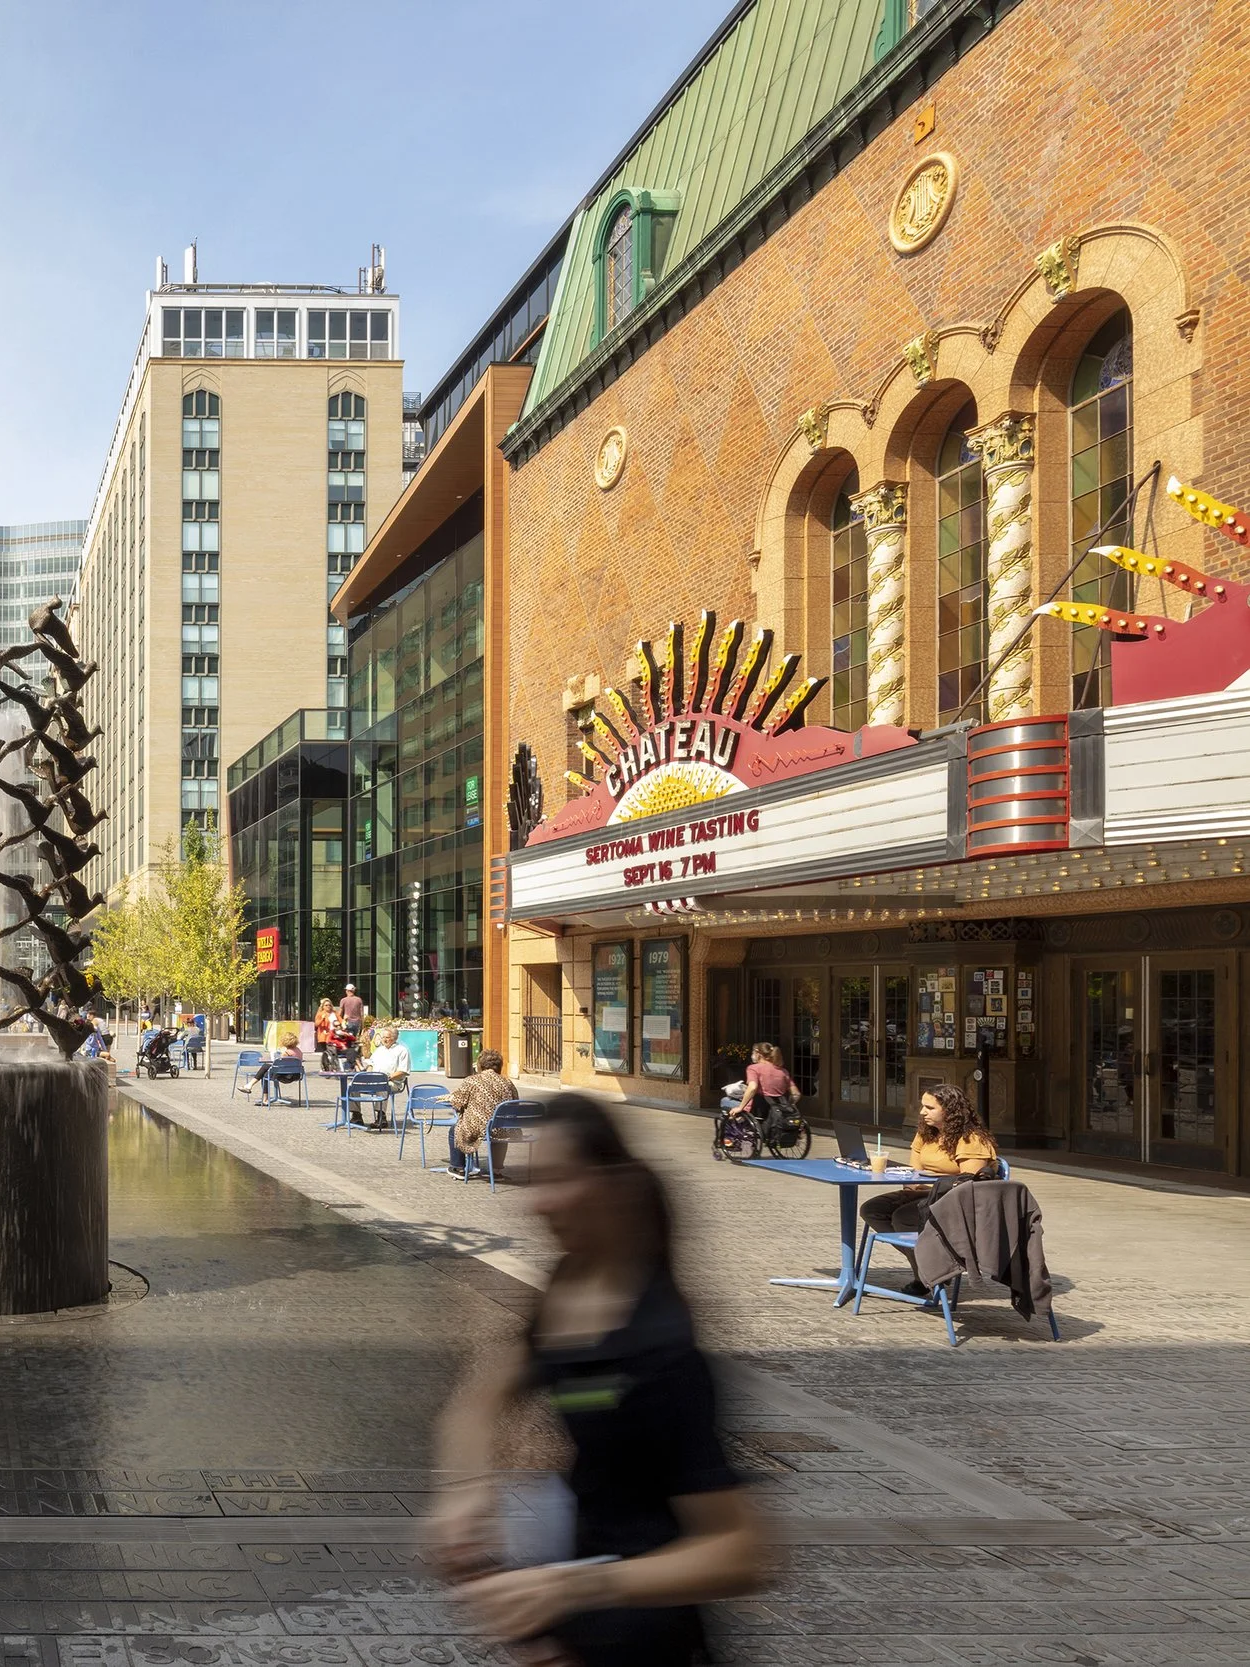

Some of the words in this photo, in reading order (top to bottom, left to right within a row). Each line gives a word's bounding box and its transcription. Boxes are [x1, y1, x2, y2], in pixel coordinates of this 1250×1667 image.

[605, 719, 737, 798] CHATEAU
[586, 835, 644, 866] SERTOMA
[648, 825, 686, 853] WINE
[689, 809, 761, 845] TASTING
[623, 864, 656, 888] SEPT
[658, 860, 673, 882] 16
[680, 857, 691, 879] 7
[692, 851, 717, 877] PM
[648, 951, 669, 964] 1979
[210, 1475, 300, 1487] THE
[225, 1496, 400, 1511] WATER
[254, 1549, 323, 1565] OF
[291, 1608, 362, 1627] OF
[775, 1608, 1062, 1626] CULTURE
[1045, 1607, 1203, 1625] AND
[140, 1640, 352, 1666] SONGS
[936, 1642, 1140, 1663] FROM
